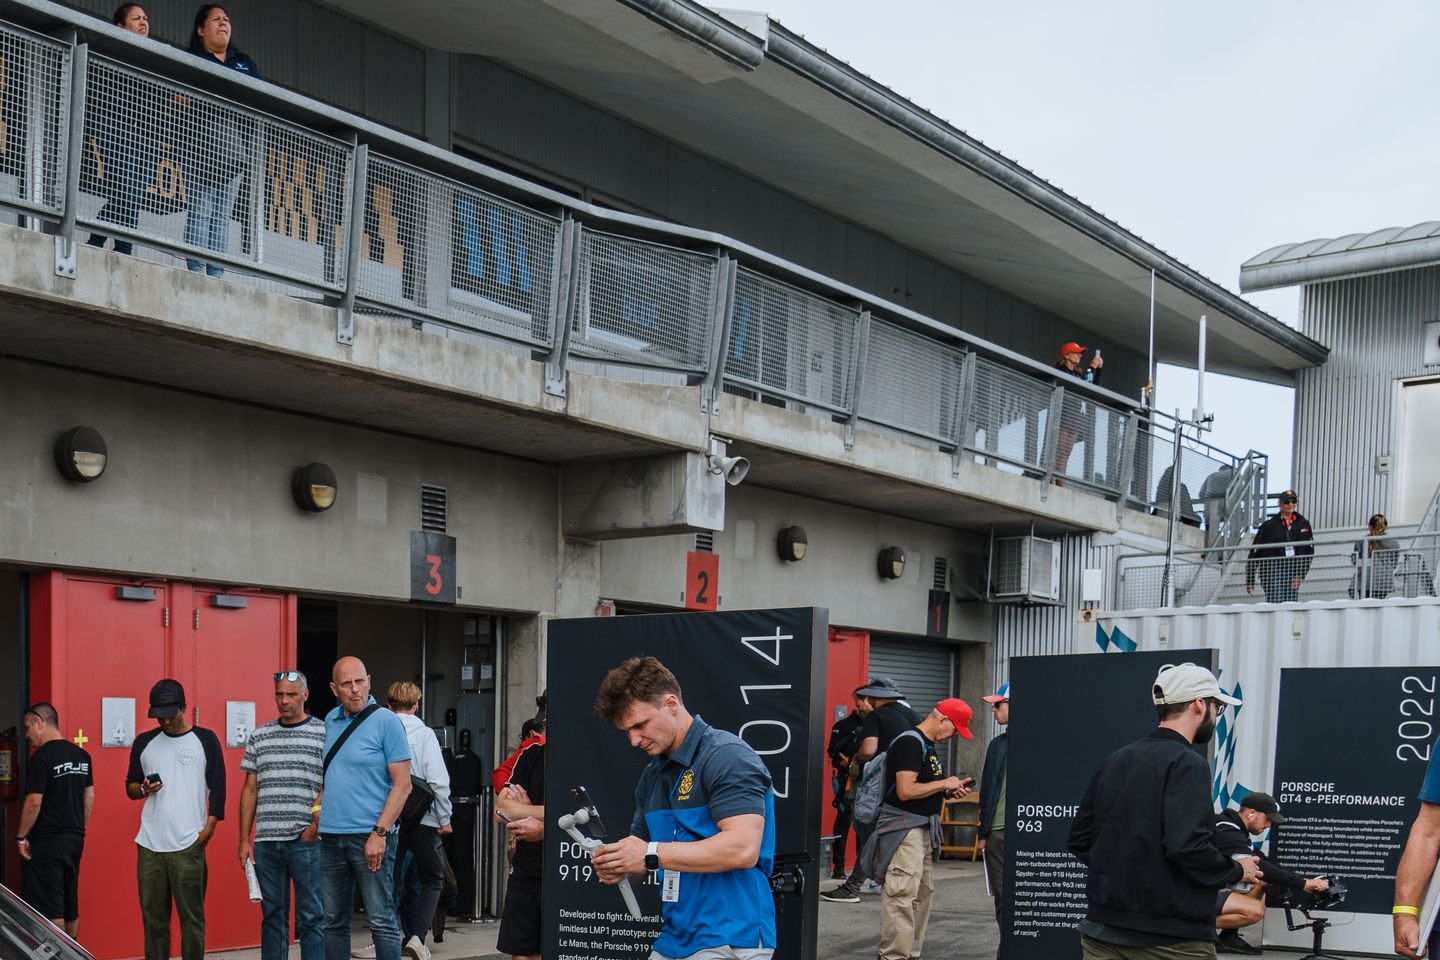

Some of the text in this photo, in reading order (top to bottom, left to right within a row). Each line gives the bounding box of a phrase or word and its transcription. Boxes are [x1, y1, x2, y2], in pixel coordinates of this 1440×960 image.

[425, 554, 443, 596] 3
[696, 570, 709, 604] 2
[936, 606, 941, 632] 1
[1396, 676, 1436, 761] 2022
[114, 721, 126, 742] 4
[236, 724, 247, 744] 3
[1281, 782, 1334, 792] PORSCHE
[1280, 794, 1405, 806] GT4 e-PERFORMANCE
[1016, 820, 1043, 833] 963
[559, 864, 592, 882] 919
[559, 909, 596, 920] Developed
[606, 912, 623, 922] fight
[559, 924, 662, 938] limitless LMP1 prototype cla
[559, 939, 567, 947] Le
[569, 940, 589, 948] Mans,
[591, 941, 602, 949] the
[604, 942, 632, 951] Porsche
[634, 944, 649, 952] 919
